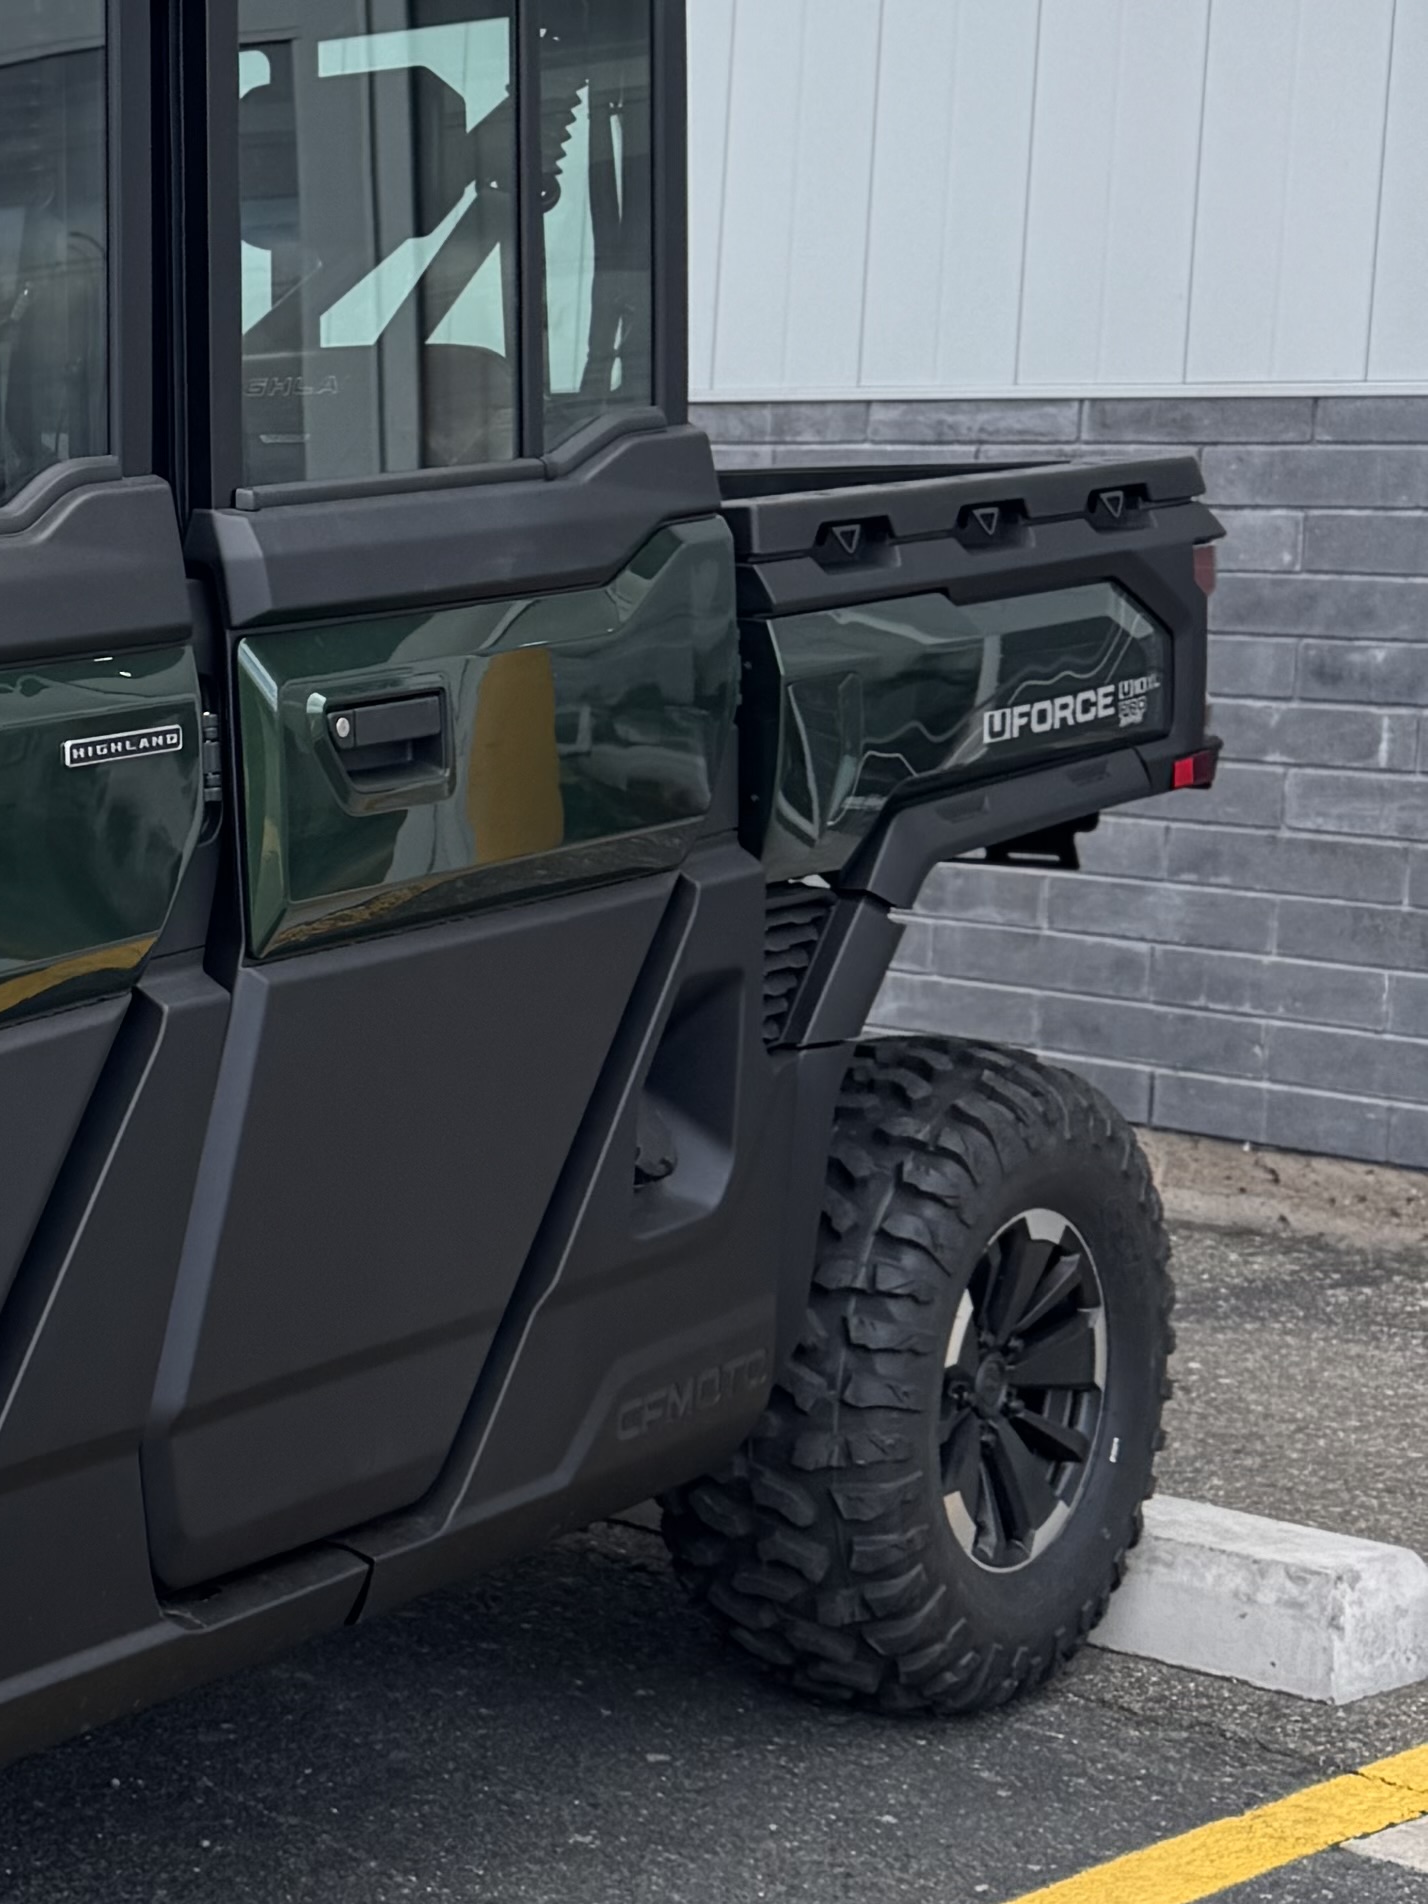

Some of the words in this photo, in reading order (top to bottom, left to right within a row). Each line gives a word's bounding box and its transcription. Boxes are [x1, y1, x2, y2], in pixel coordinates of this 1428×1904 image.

[983, 684, 1115, 744] UFORCE
[71, 733, 178, 760] HIGHLAND
[617, 1348, 768, 1441] CFMOTO
